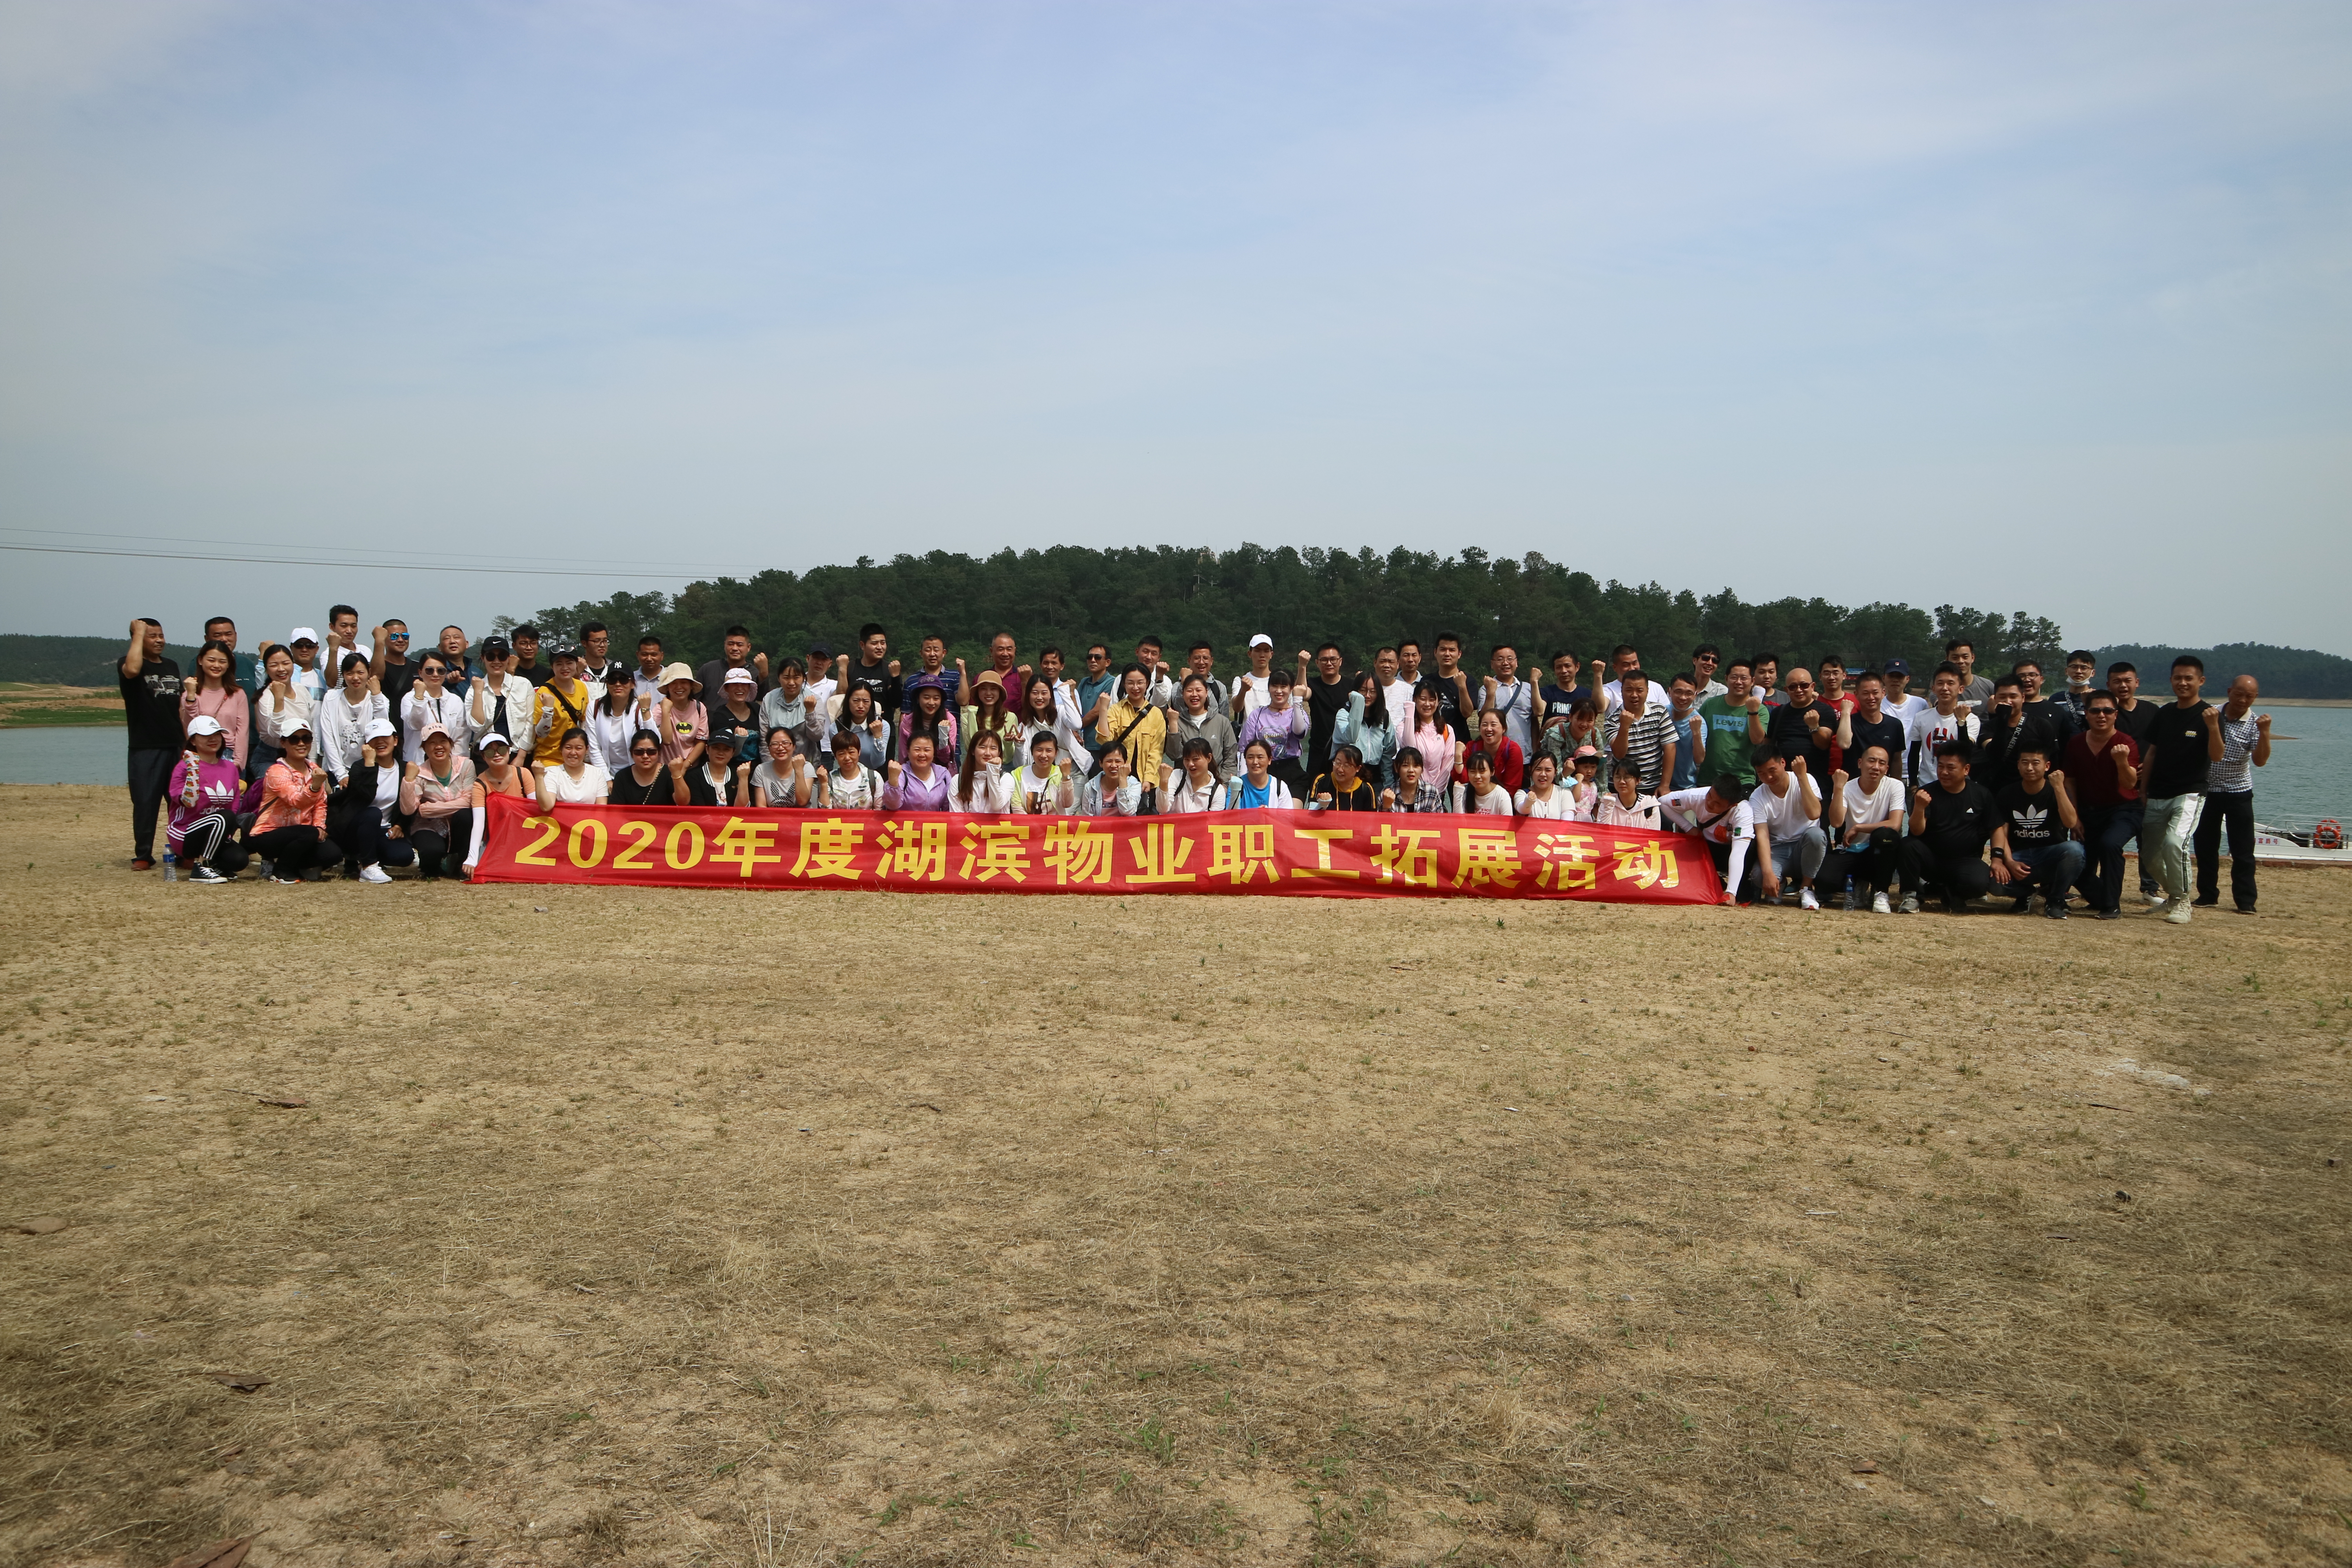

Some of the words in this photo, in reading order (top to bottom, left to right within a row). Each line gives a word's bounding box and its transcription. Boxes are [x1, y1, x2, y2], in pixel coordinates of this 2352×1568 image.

[514, 817, 1680, 891] 2020年度湖滨物业职工拓展活动
